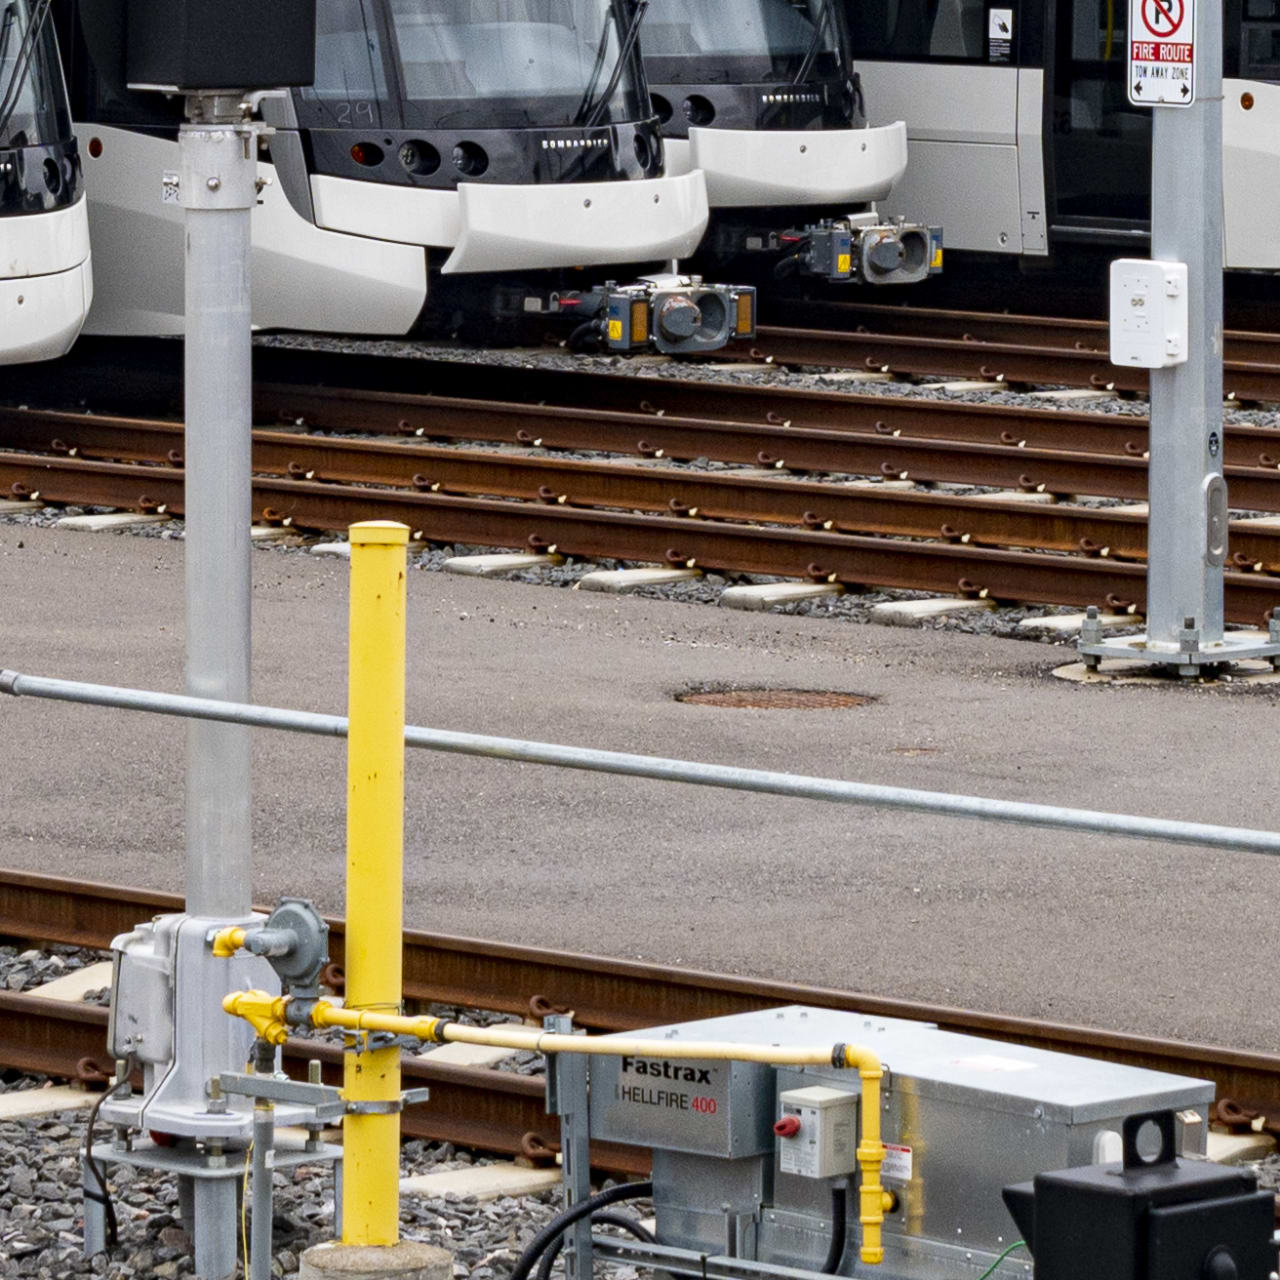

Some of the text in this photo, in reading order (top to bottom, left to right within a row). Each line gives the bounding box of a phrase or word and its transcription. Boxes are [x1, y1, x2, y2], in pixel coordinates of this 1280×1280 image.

[1133, 43, 1192, 62] FIRE ROUTE
[1135, 65, 1189, 81] TOW AWAY ZONE
[622, 1055, 712, 1085] Fastrax
[622, 1085, 718, 1115] HELLFIRE 400
